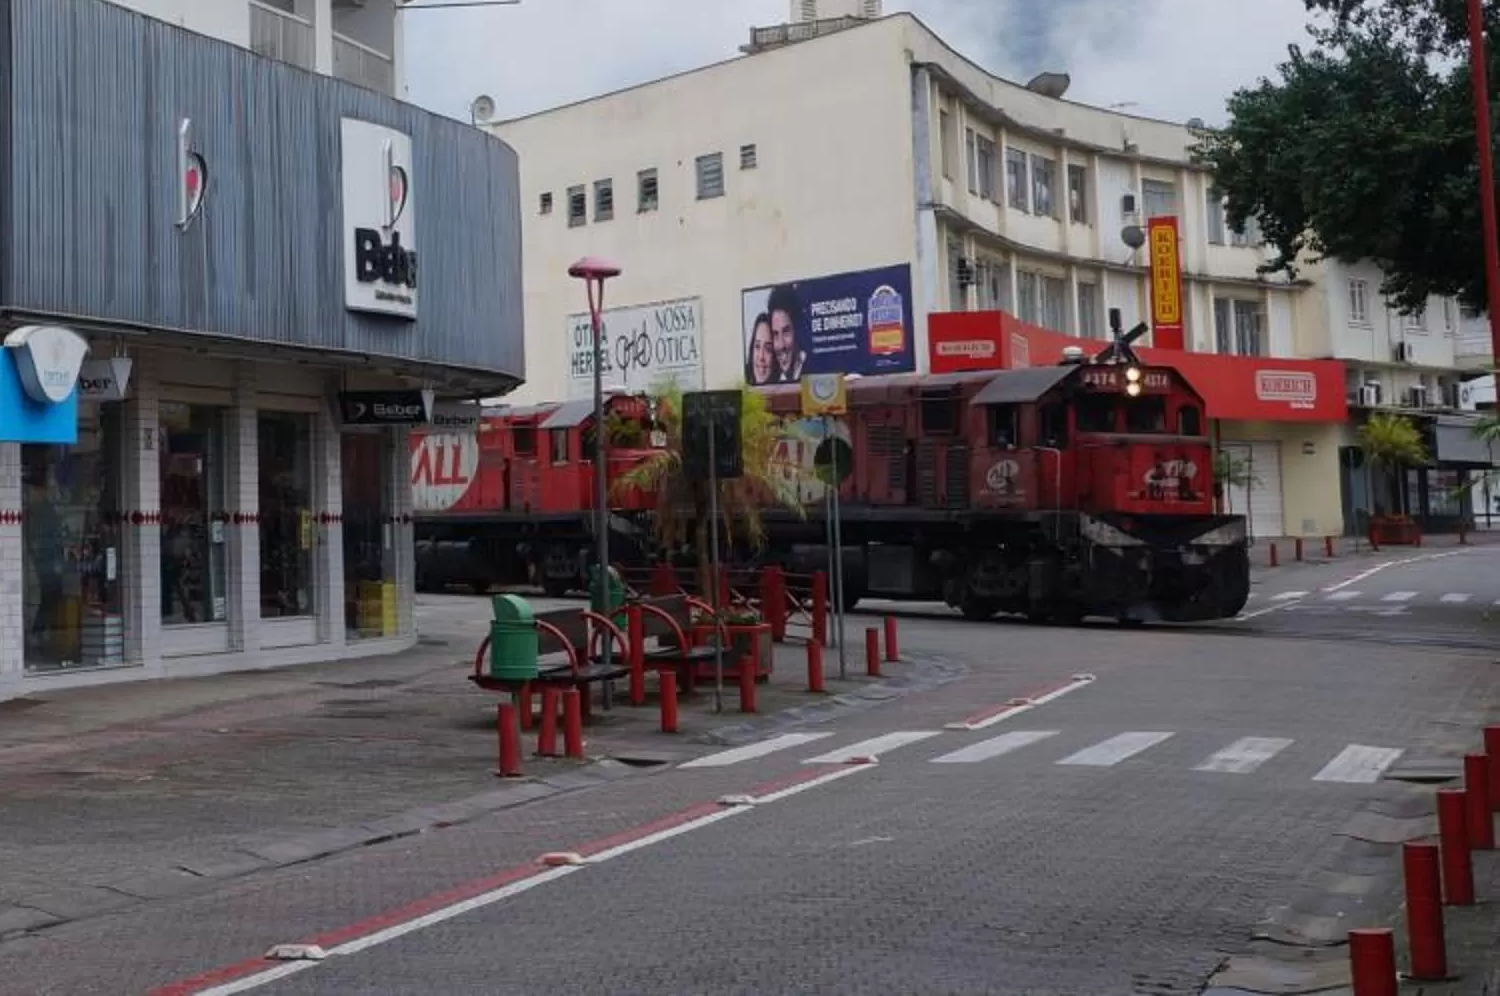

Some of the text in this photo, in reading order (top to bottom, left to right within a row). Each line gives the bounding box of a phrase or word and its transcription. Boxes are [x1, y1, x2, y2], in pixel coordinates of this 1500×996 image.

[655, 305, 695, 333] NOSSA
[811, 318, 822, 332] DE
[571, 349, 613, 376] HEREL
[411, 435, 469, 484] ALL
